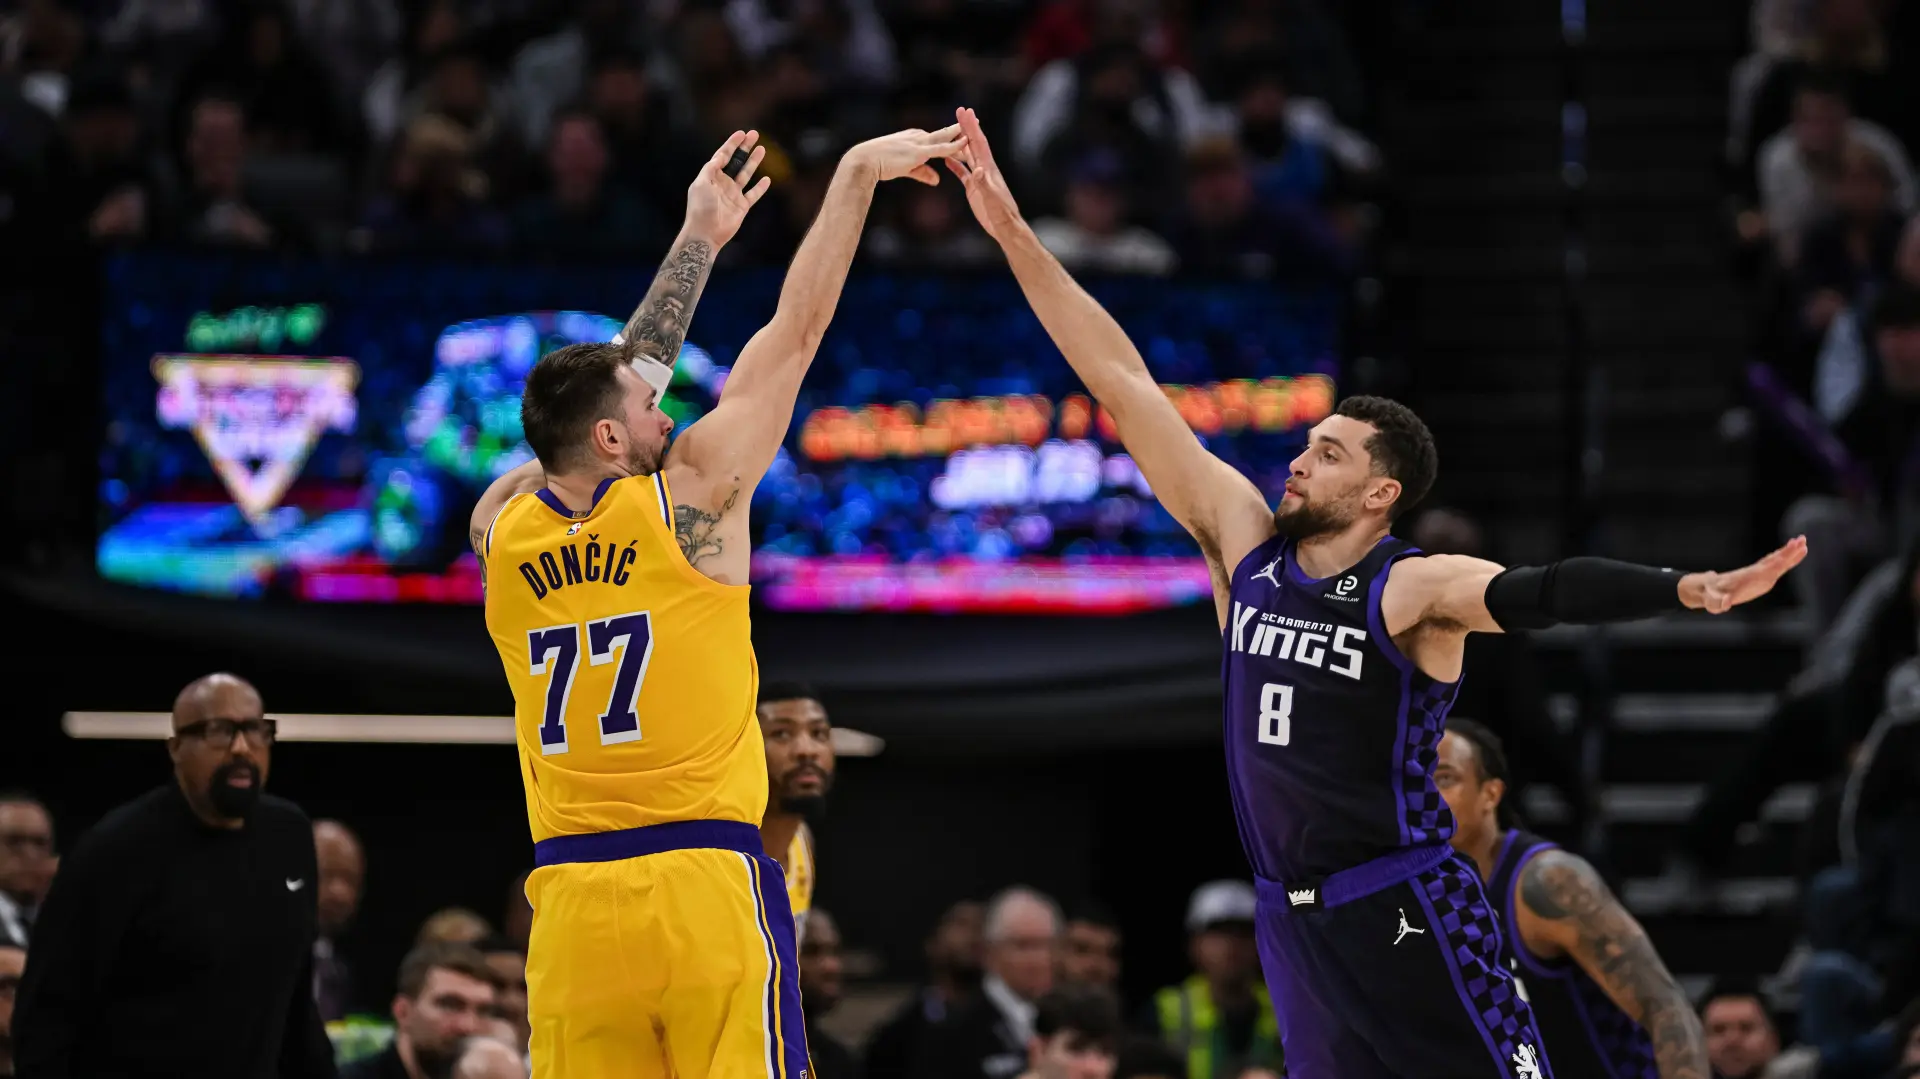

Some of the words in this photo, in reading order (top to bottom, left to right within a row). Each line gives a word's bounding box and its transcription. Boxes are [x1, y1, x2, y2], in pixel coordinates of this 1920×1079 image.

[518, 533, 639, 600] DONČIĆ
[1231, 601, 1367, 680] KINGS
[526, 610, 654, 756] 77
[1258, 682, 1294, 747] 8
